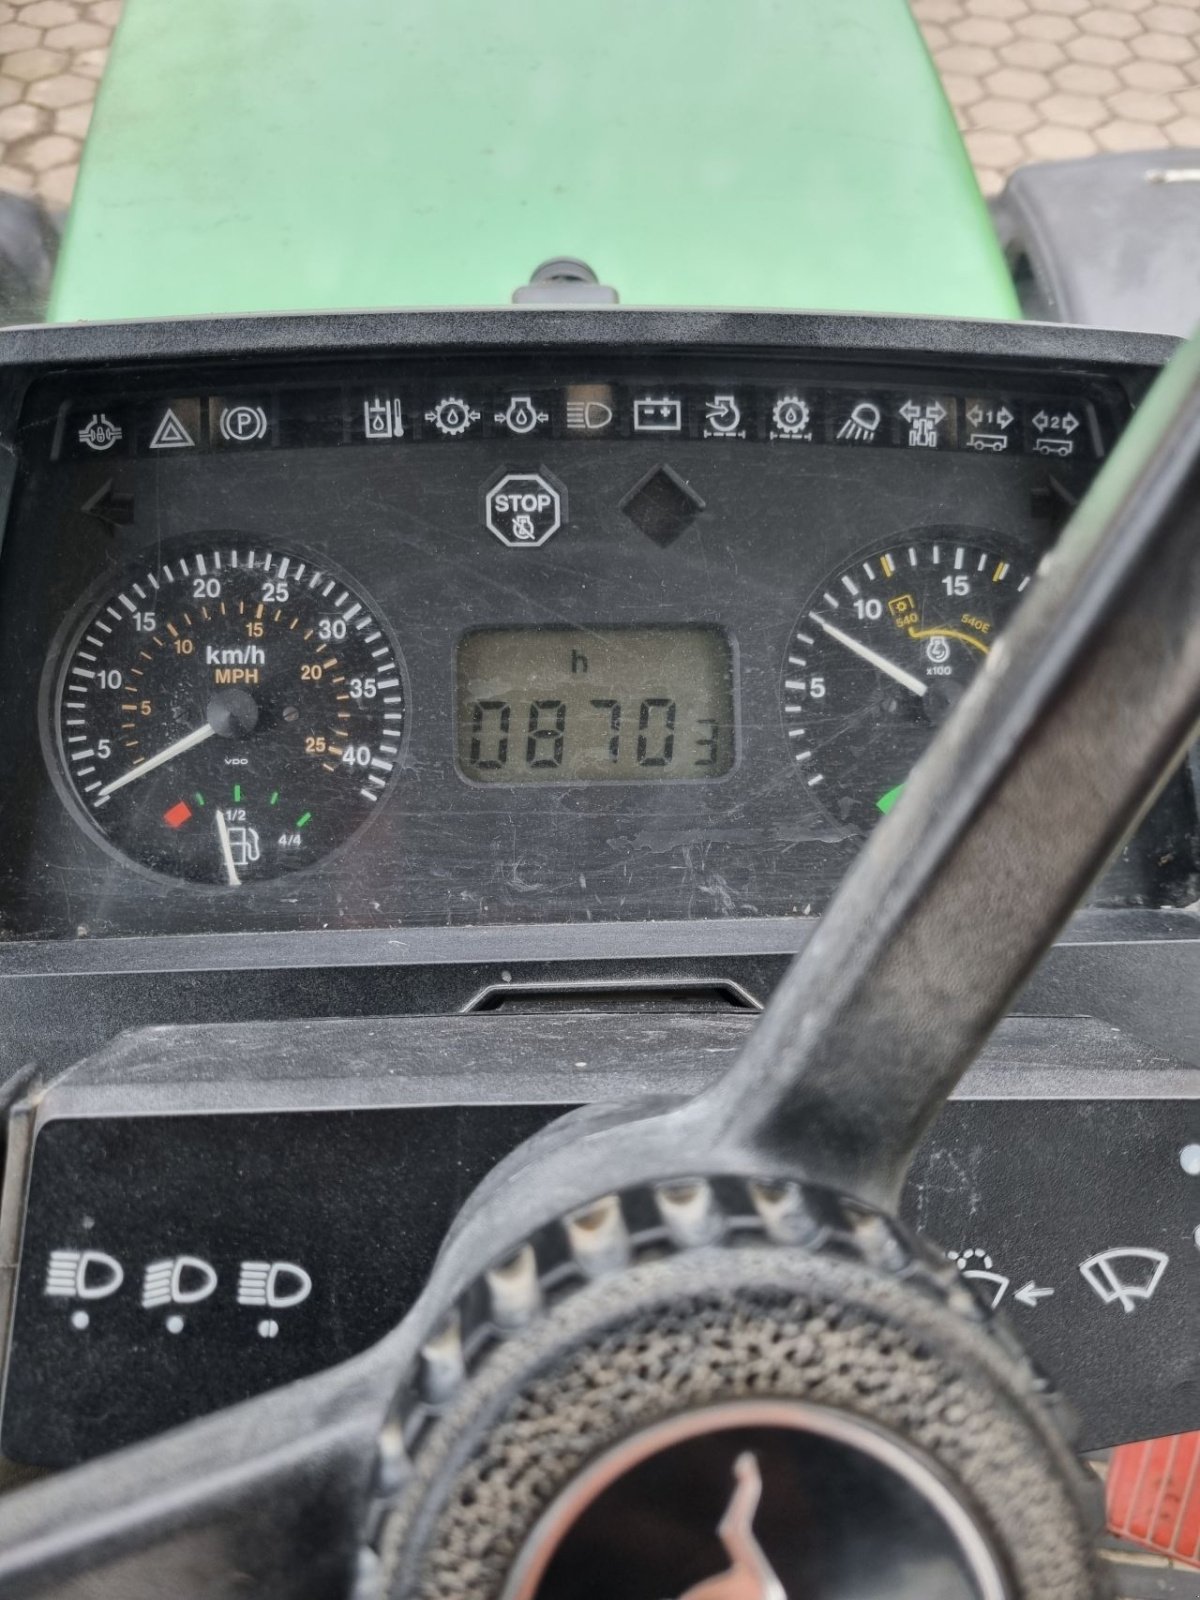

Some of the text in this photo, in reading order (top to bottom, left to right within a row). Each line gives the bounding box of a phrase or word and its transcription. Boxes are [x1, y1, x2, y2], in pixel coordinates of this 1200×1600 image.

[237, 412, 252, 435] P
[985, 411, 993, 423] 1
[1050, 416, 1060, 429] 2
[494, 494, 551, 513] STOP
[192, 579, 222, 599] 20
[262, 583, 290, 603] 25
[942, 575, 970, 596] 15
[853, 599, 882, 620] 10
[134, 611, 157, 632] 15
[318, 620, 346, 639] 30
[896, 613, 918, 628] 540
[961, 613, 991, 633] 540E
[246, 624, 264, 638] 15
[174, 640, 193, 655] 10
[206, 646, 265, 666] km/h
[571, 650, 589, 674] h
[926, 666, 951, 676] x100
[98, 672, 122, 690] 10
[215, 669, 259, 685] MPH
[300, 666, 322, 681] 20
[350, 680, 377, 699] 35
[810, 678, 826, 698] 5
[141, 701, 152, 716] 5
[97, 740, 111, 759] 5
[305, 736, 326, 753] 25
[342, 748, 371, 767] 40
[225, 810, 246, 821] 1/2
[278, 834, 302, 846] 4/4
